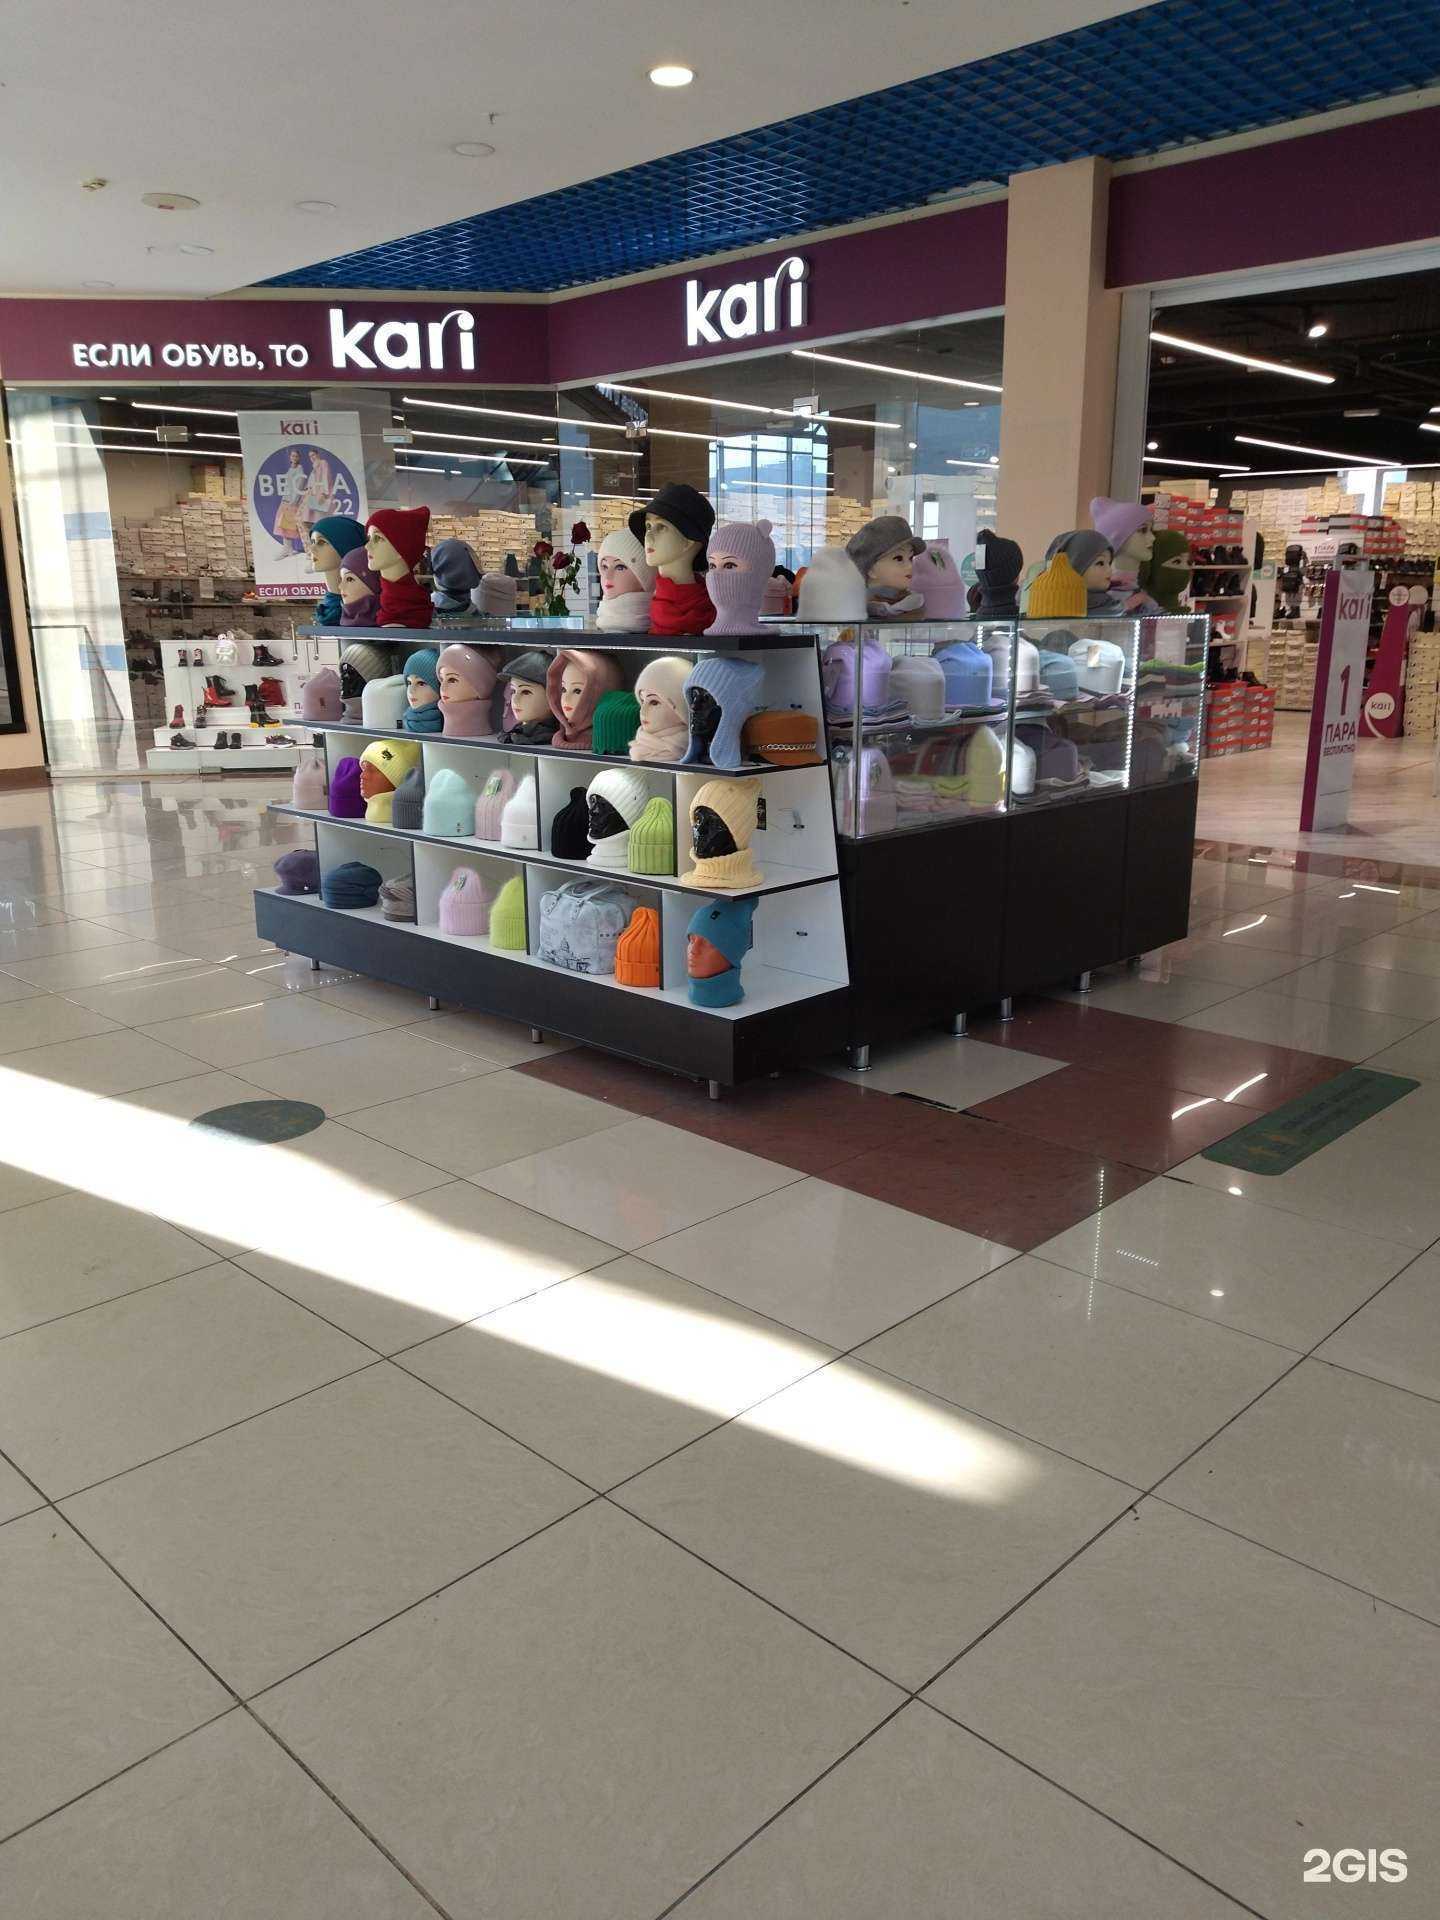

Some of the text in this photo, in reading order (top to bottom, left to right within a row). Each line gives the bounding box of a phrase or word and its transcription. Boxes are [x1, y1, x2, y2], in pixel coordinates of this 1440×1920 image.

[686, 256, 805, 346] kari
[72, 308, 475, 371] ЕСЛИ ОБУВЬ, ТО kari
[280, 420, 320, 436] kari
[332, 498, 354, 516] 22
[258, 587, 289, 597] ЕСЛИ
[1337, 591, 1372, 621] kari
[1340, 664, 1351, 717] 1
[1371, 701, 1391, 711] kari
[1324, 720, 1356, 744] ПАРА
